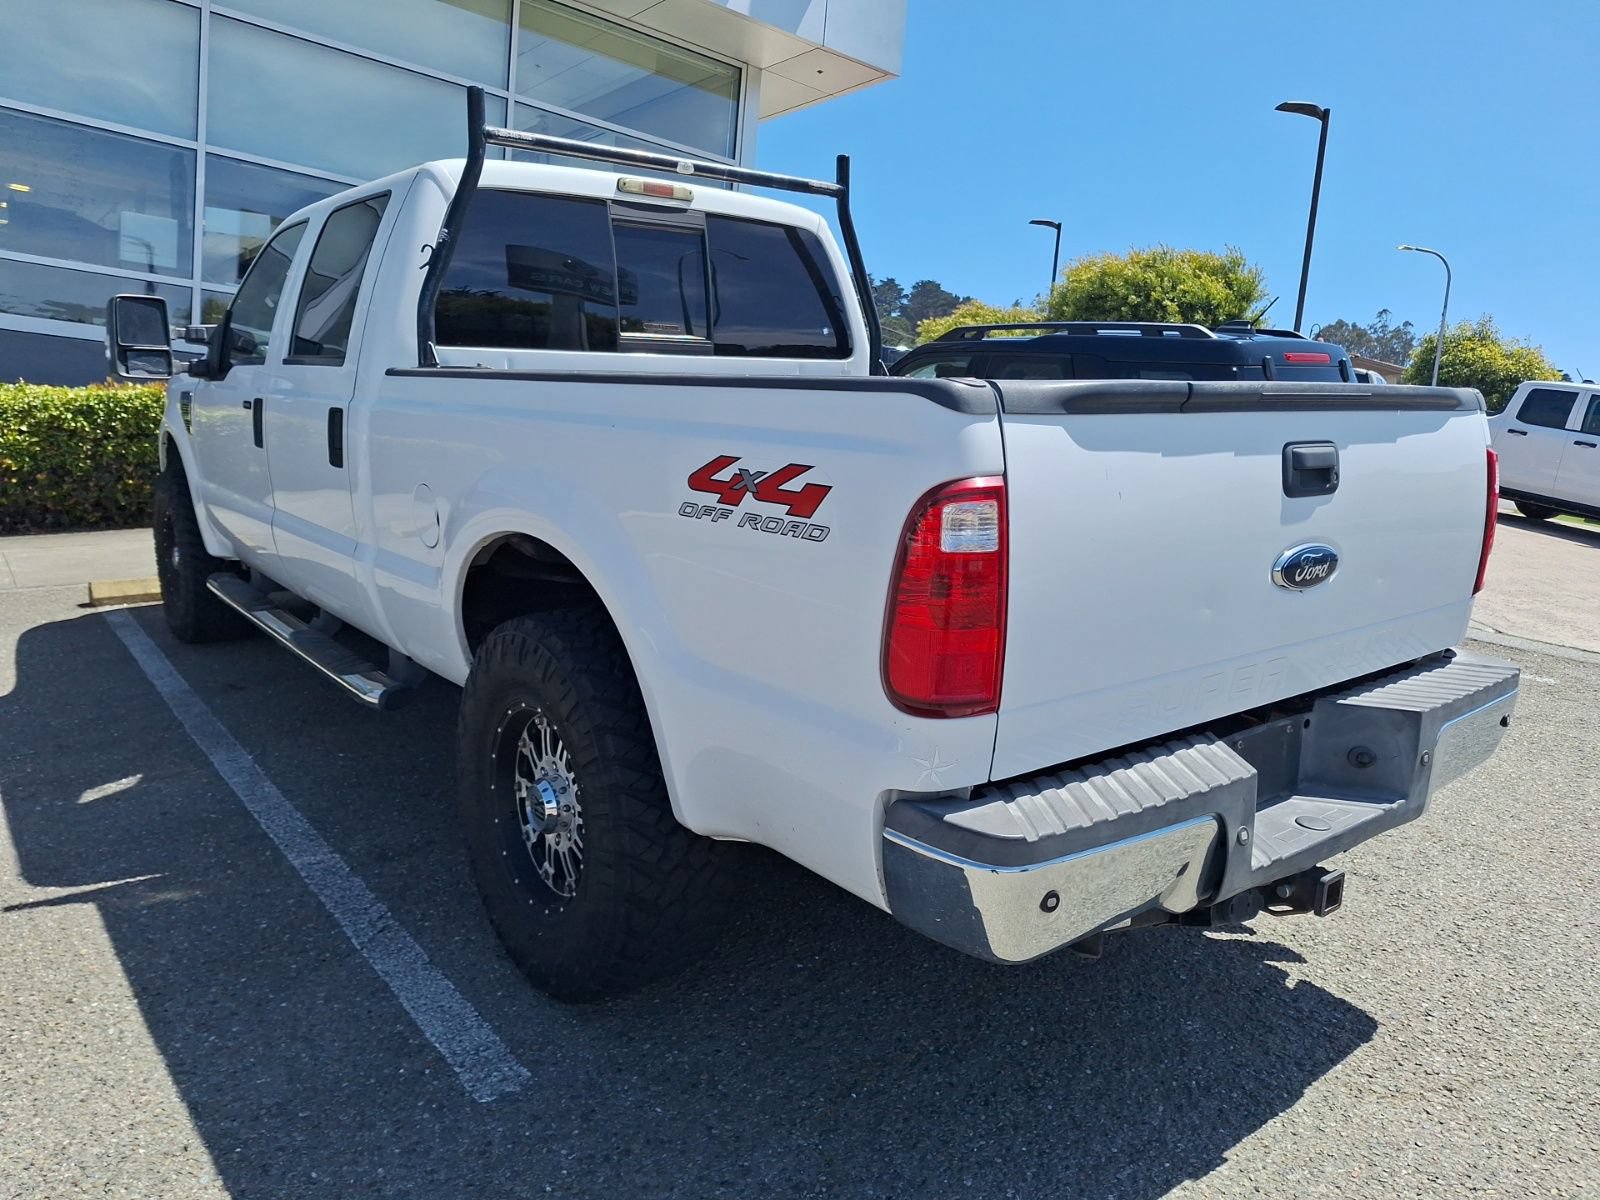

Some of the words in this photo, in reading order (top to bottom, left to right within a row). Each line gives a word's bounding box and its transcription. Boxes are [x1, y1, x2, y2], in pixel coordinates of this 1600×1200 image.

[678, 502, 734, 523] OFF
[737, 512, 831, 542] ROAD
[1295, 553, 1331, 582] Ford
